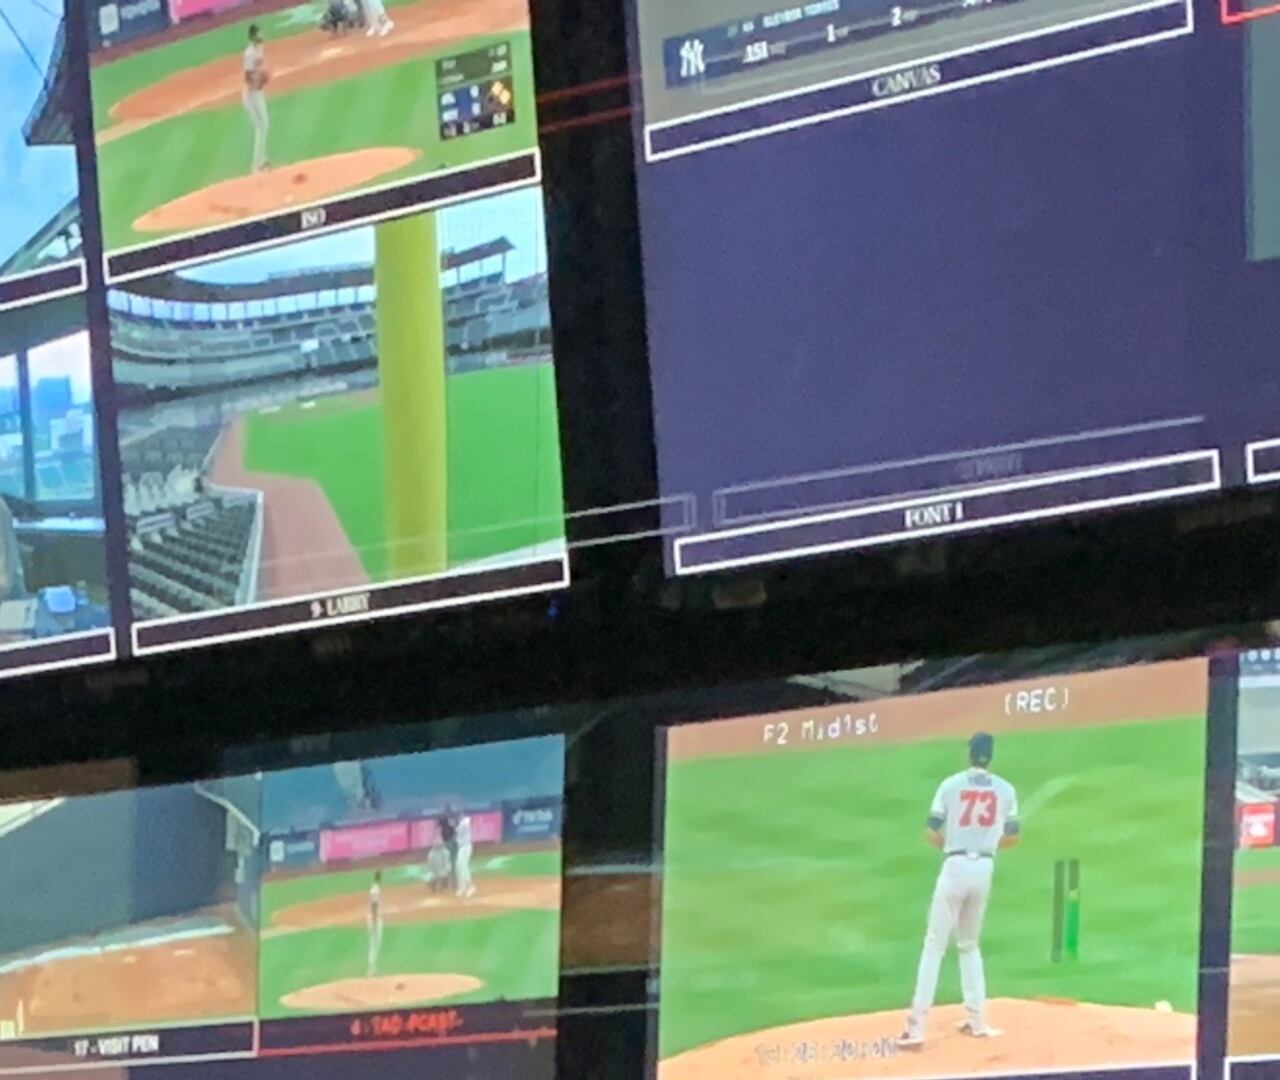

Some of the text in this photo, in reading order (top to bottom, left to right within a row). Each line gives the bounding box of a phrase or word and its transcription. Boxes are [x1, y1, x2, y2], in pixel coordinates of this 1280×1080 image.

[872, 64, 942, 97] CANVAS
[905, 503, 953, 528] FONT
[763, 722, 789, 745] F2
[958, 789, 998, 828] 73
